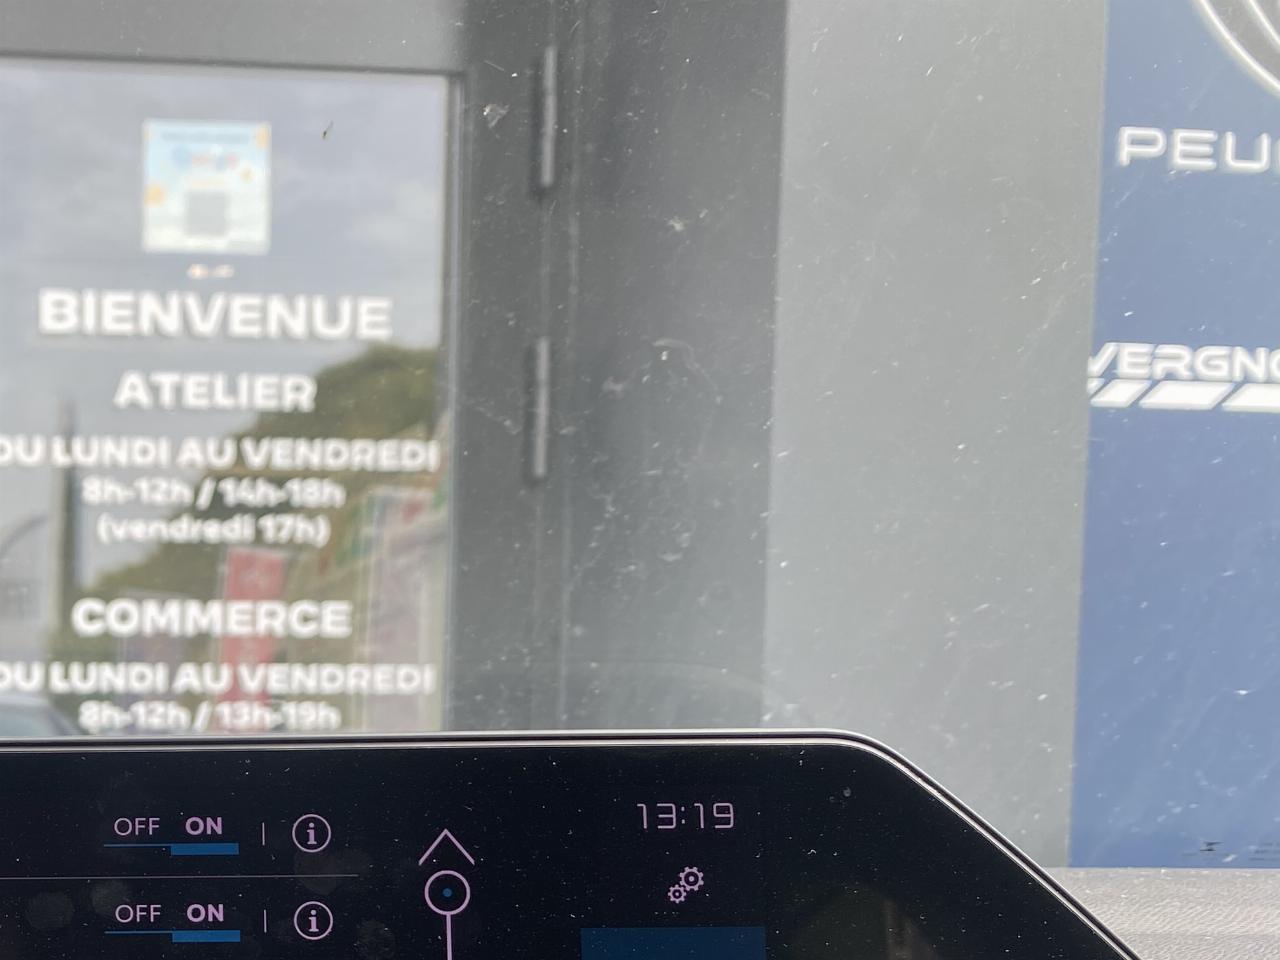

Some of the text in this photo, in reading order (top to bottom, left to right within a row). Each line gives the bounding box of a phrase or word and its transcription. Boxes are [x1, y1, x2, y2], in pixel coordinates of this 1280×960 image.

[1118, 126, 1280, 174] PEU
[38, 289, 394, 339] BIENVENUE
[114, 370, 318, 412] ATELIER
[51, 435, 169, 467] LUNDI
[176, 437, 235, 468] AU
[240, 438, 440, 471] VENDREDI
[81, 477, 192, 506] 8h-12h
[219, 477, 347, 507] 14h-18h
[97, 513, 330, 547] (vendredi 17h)
[72, 598, 353, 637] COMMERCE
[50, 662, 169, 694] LUNDI
[173, 663, 233, 695] AU
[236, 663, 435, 695] VENDREDI
[78, 700, 190, 732] 8h-12h
[114, 816, 223, 836] OFF ON
[636, 802, 735, 829] 13:19
[115, 903, 224, 923] OFF ON
